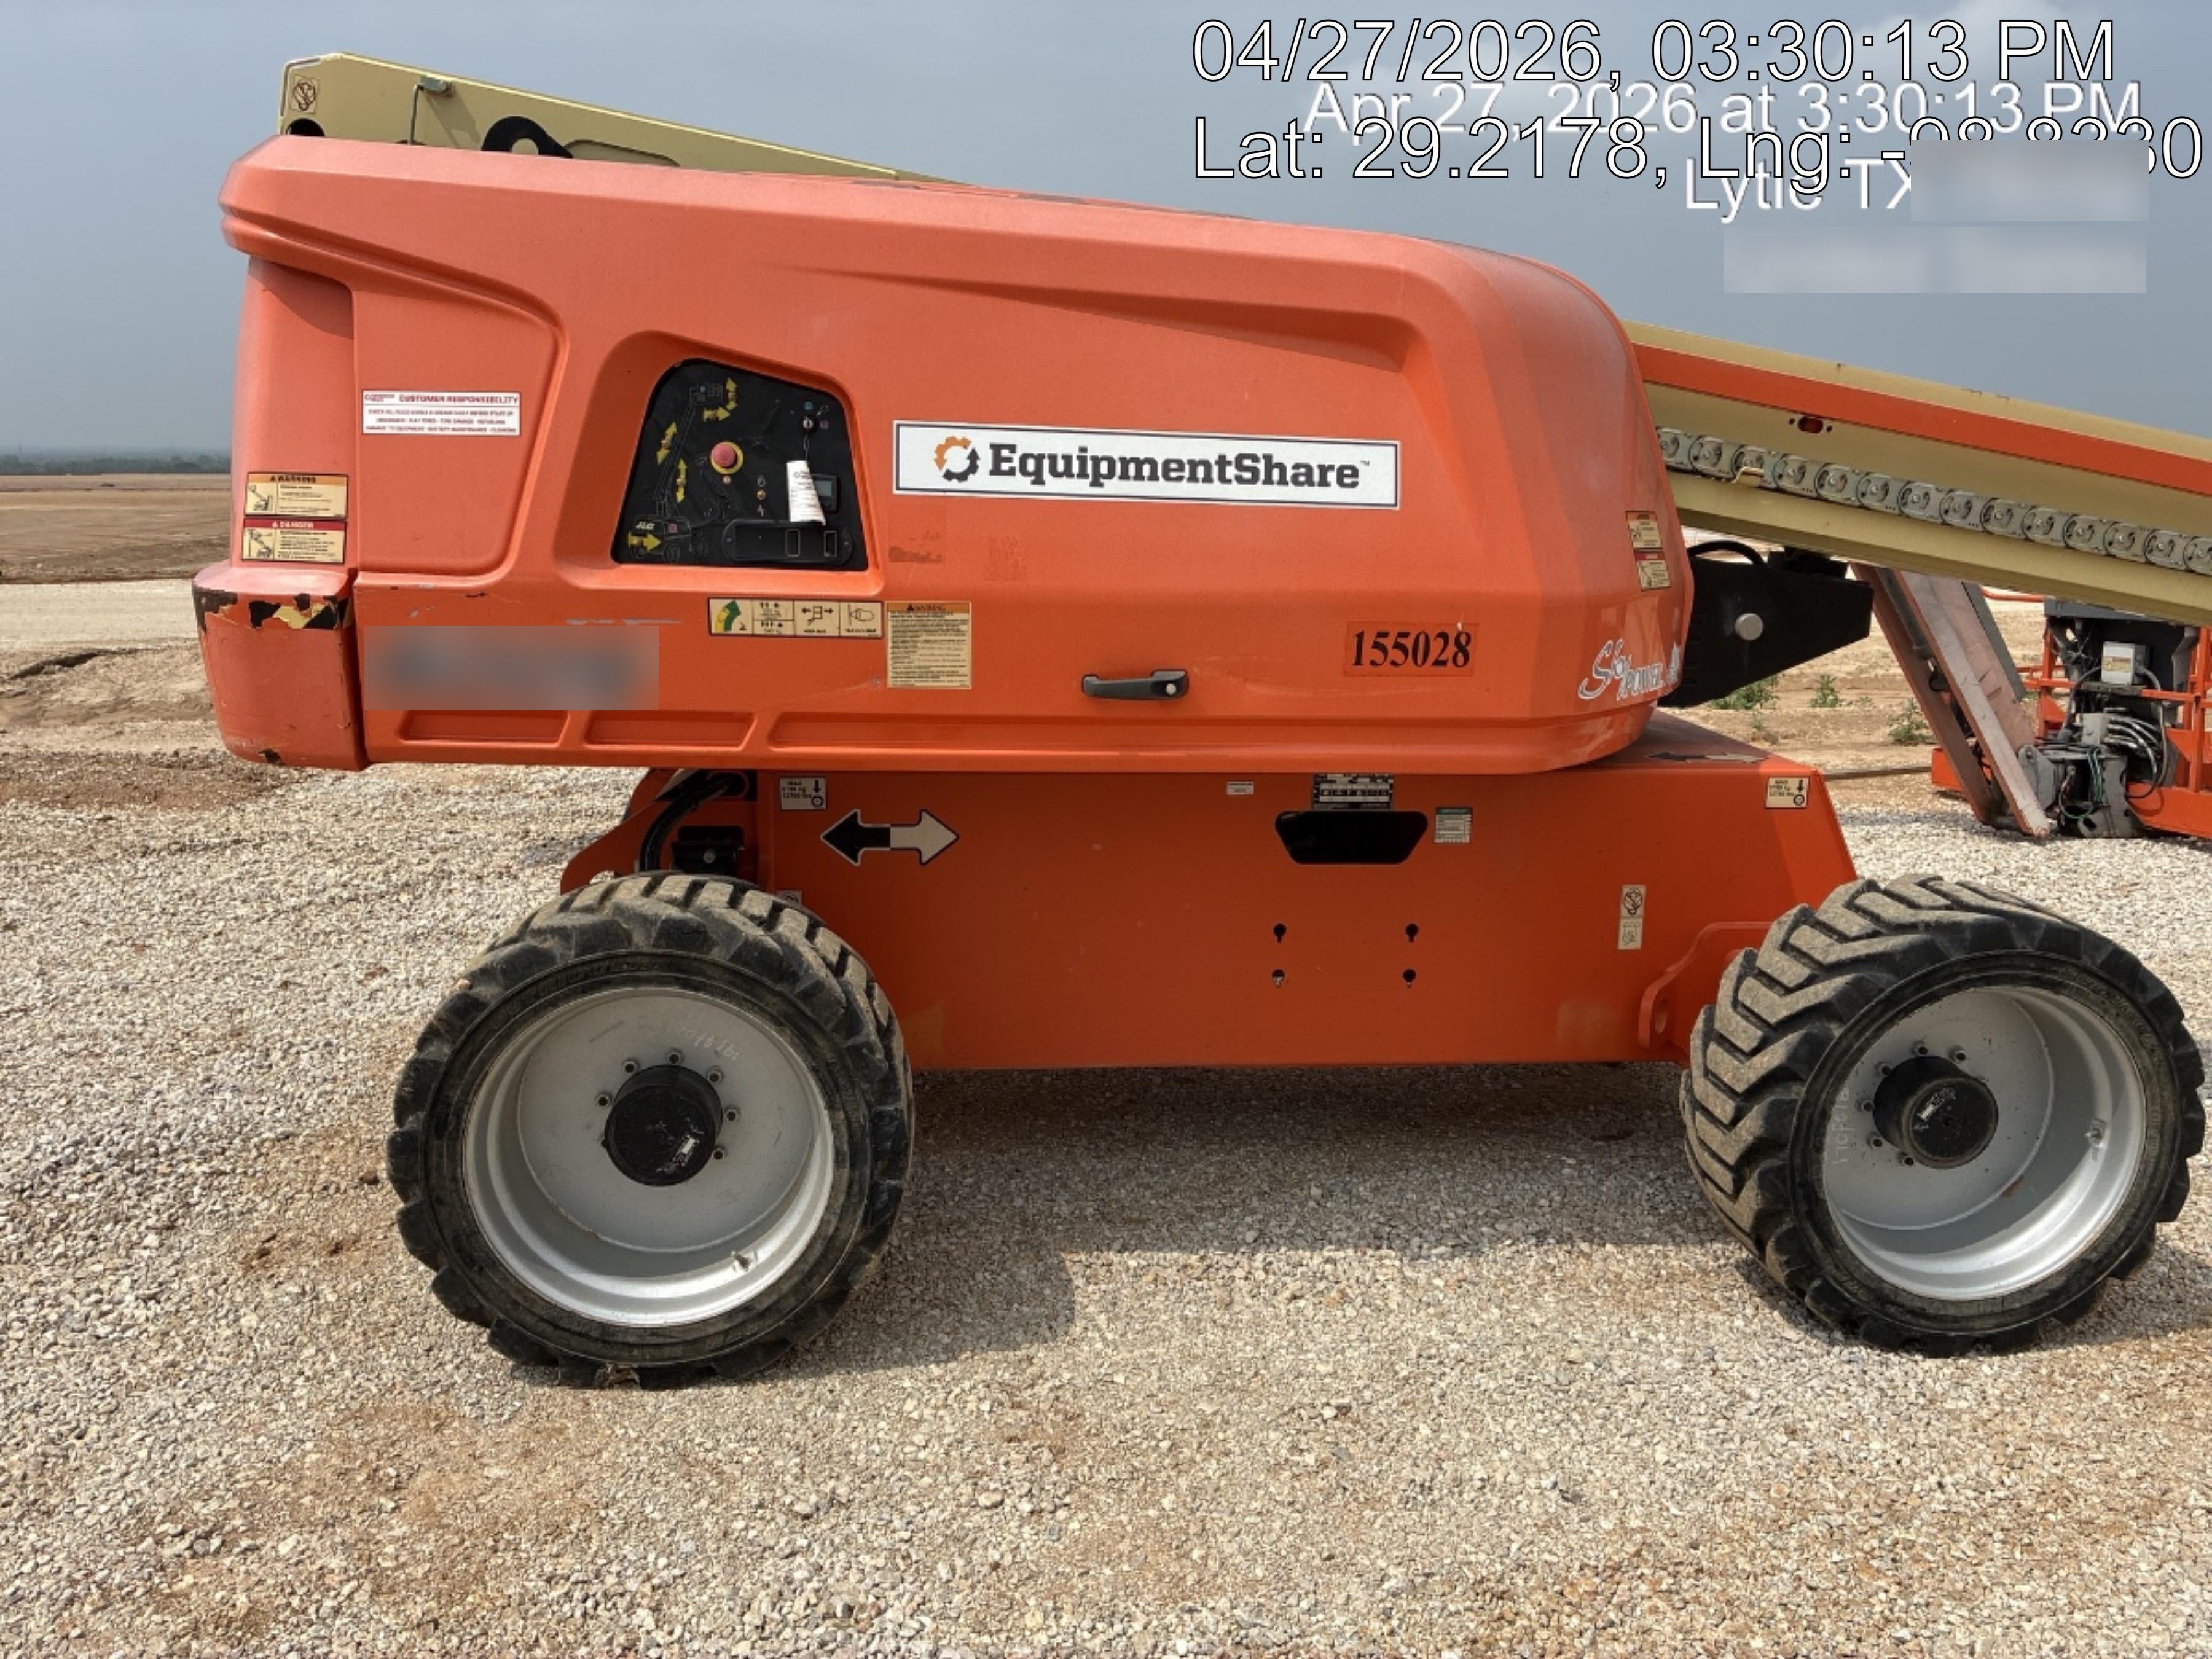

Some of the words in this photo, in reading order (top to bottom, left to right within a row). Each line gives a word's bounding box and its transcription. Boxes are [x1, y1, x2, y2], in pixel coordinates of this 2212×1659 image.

[446, 395, 519, 404] RESPONSIBILITY
[989, 442, 1360, 490] EquipmentShare
[1352, 630, 1472, 667] 155028
